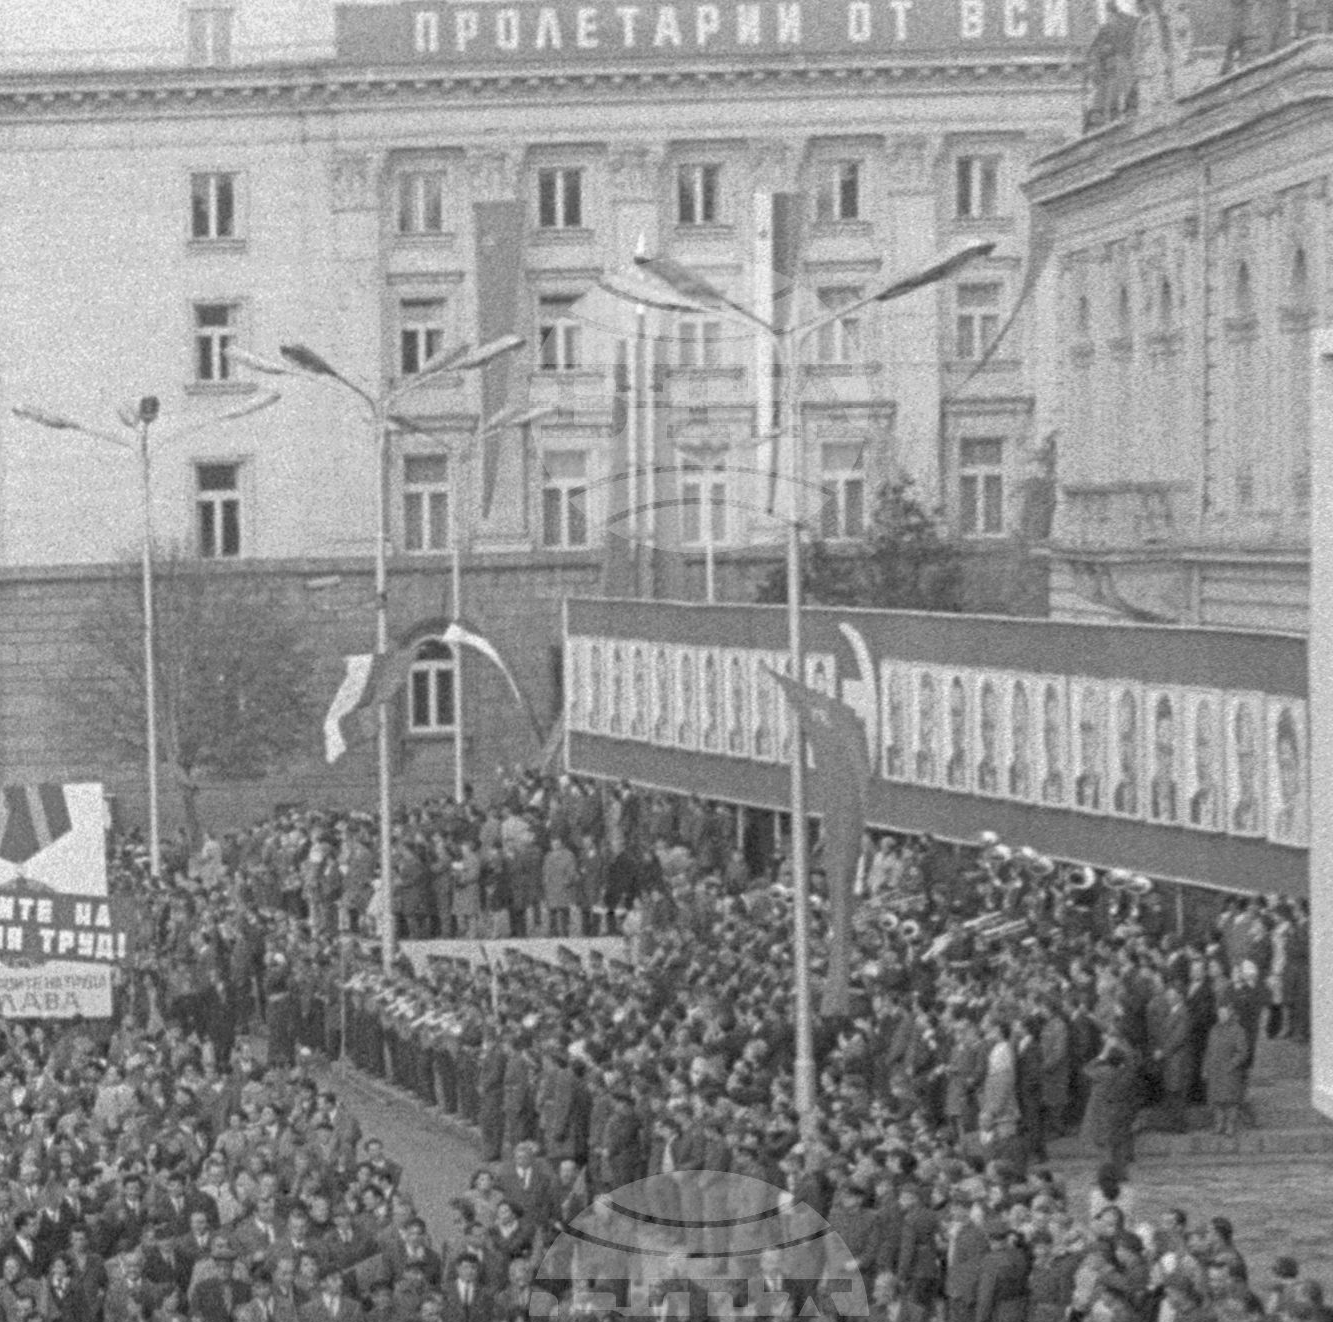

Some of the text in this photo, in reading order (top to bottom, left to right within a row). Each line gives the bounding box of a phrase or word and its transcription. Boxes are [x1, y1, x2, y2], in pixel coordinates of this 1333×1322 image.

[414, 2, 803, 52] ПРОЛЕТАРИИ
[847, 0, 913, 42] ОТ
[73, 901, 113, 929] НА
[38, 926, 129, 961] ТРУД!
